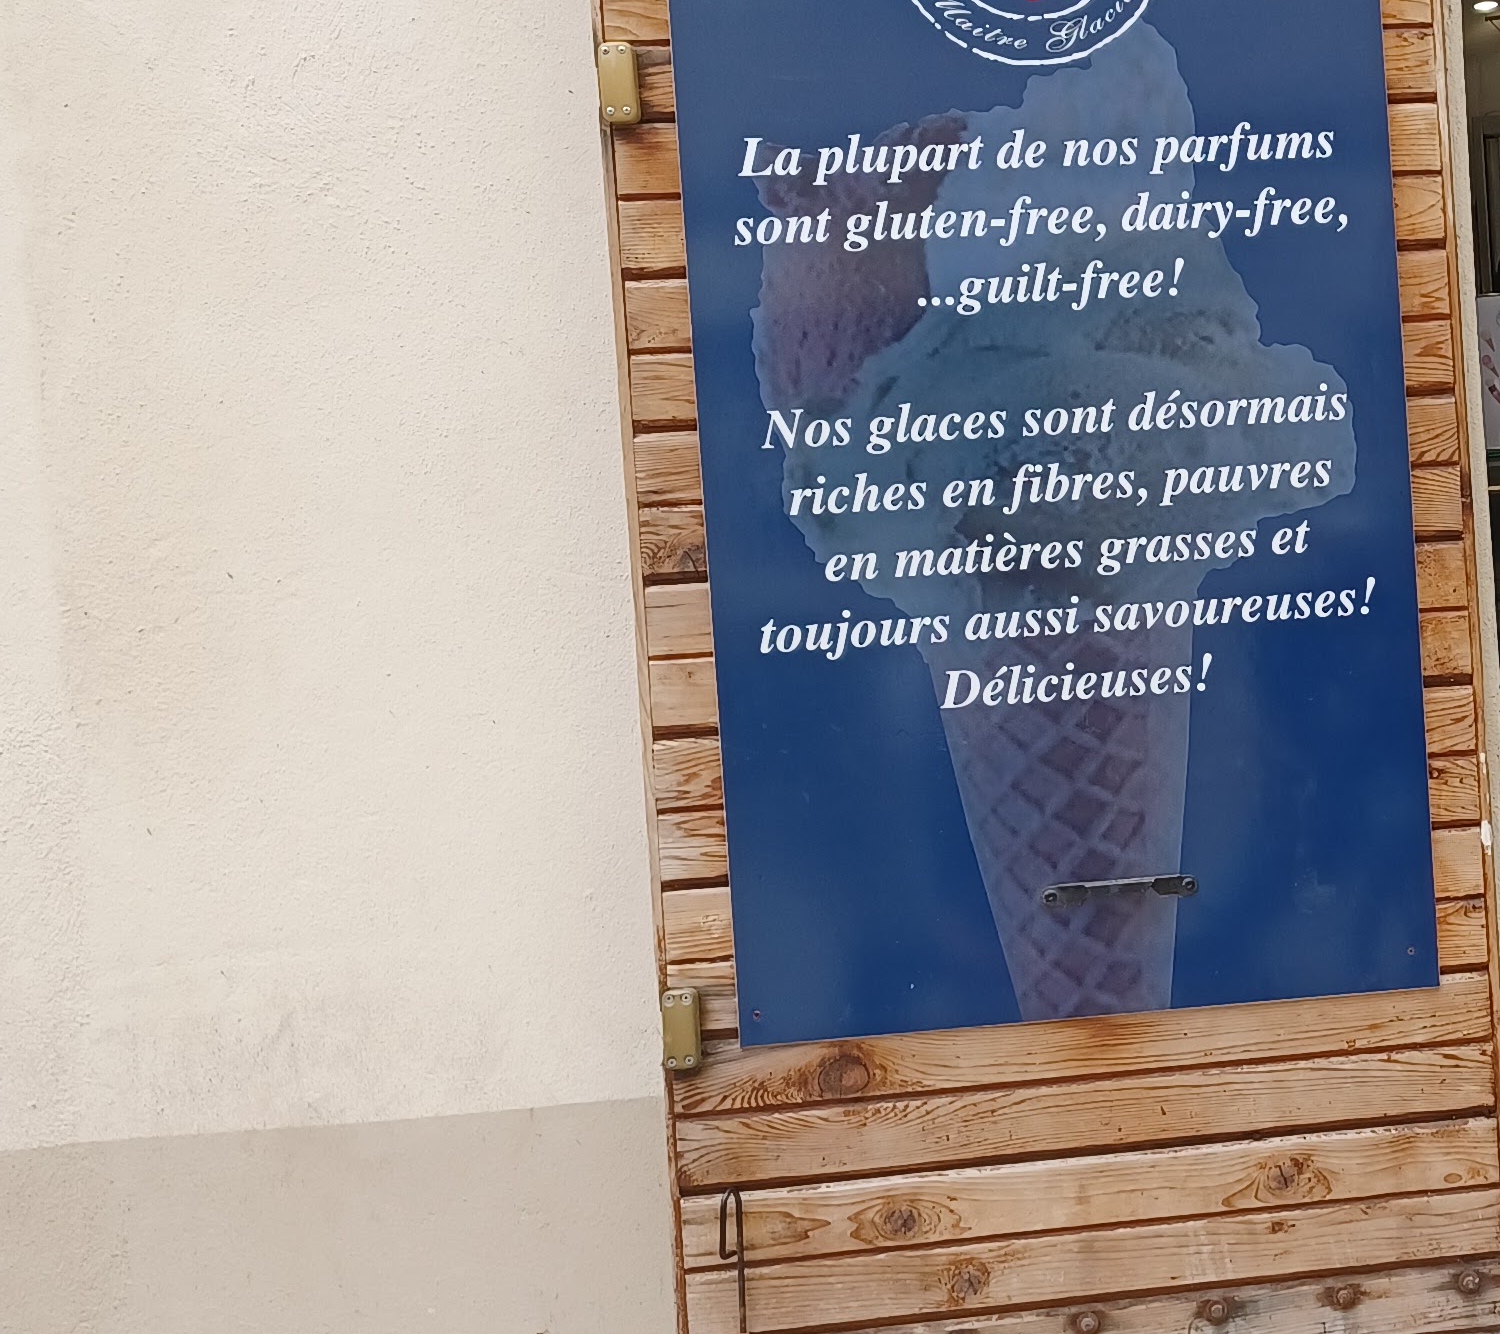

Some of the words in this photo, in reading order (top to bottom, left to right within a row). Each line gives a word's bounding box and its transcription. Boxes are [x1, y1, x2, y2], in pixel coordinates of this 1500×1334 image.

[737, 137, 802, 177] La
[812, 133, 985, 186] plupart
[996, 128, 1047, 170] de
[1062, 137, 1138, 167] nos
[1149, 121, 1334, 175] parfums
[734, 207, 832, 246] sont
[843, 195, 1107, 252] gluten-free,
[1121, 186, 1348, 239] dairy-free,
[917, 257, 1185, 316] ...guilt-free!
[761, 408, 852, 449] Nos
[865, 402, 1007, 455] glaces
[1022, 398, 1117, 437] sont
[1127, 382, 1348, 432] désormais
[789, 472, 927, 516] riches
[942, 478, 996, 508] en
[1002, 462, 1148, 515] fibres,
[1158, 459, 1332, 507] pauvres
[824, 552, 879, 582] en
[894, 532, 1084, 578] matières
[1096, 529, 1257, 576] grasses
[1271, 519, 1311, 555] et
[760, 609, 950, 661] toujours
[964, 595, 1080, 641] aussi
[1093, 576, 1376, 633] savoureuses!
[939, 652, 1213, 709] Délicieuses!
